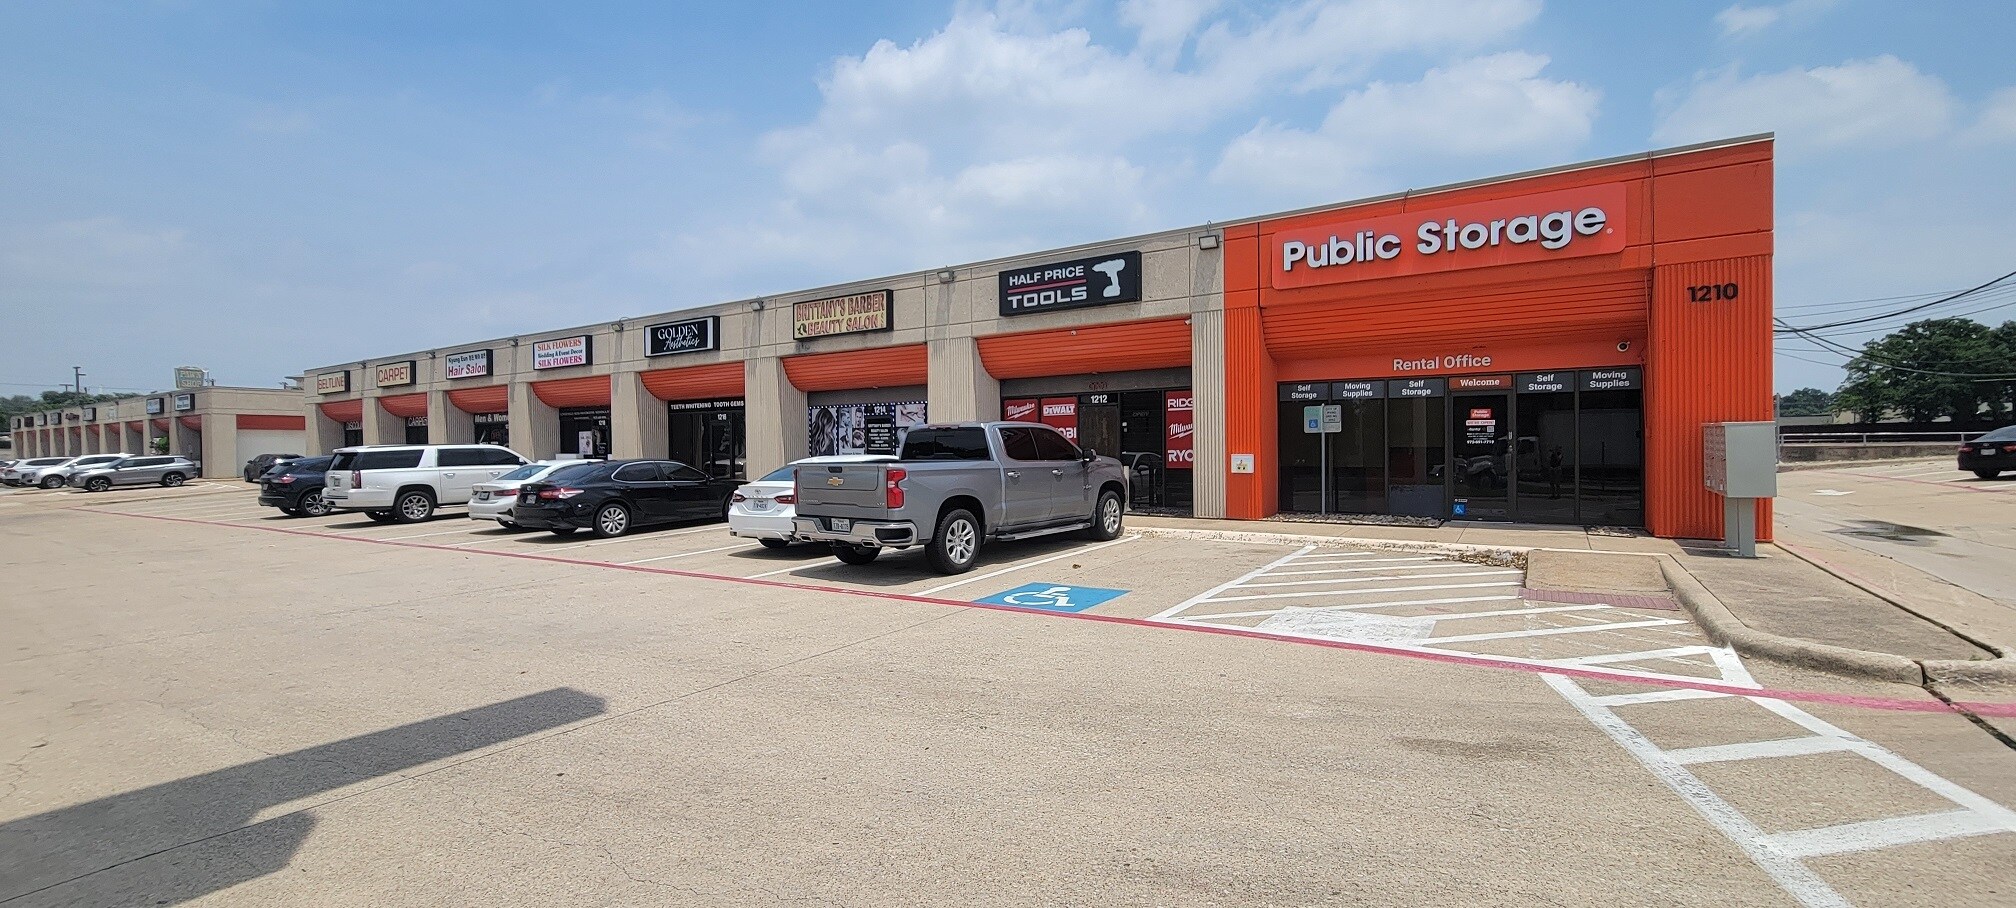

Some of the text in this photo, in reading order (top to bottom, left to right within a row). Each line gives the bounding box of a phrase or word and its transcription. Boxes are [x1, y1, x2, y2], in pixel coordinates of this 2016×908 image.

[1283, 207, 1607, 271] Public Storage
[1009, 265, 1084, 286] HALF PRICE
[1007, 286, 1087, 309] TOOLS
[1687, 283, 1738, 302] 1210
[796, 293, 885, 322] BRITTANY'S BARBER
[808, 318, 845, 335] BEAUTY
[846, 314, 879, 331] SALON
[658, 324, 699, 339] GOLDEN
[537, 338, 582, 351] SILK FLOWERS
[663, 335, 700, 350] Aesthetics
[538, 355, 582, 367] SILK FLOWERS
[1393, 354, 1492, 371] Rental Office
[377, 366, 409, 383] CARPET
[448, 362, 486, 377] Hair Salon
[1459, 377, 1500, 387] Welcome
[1536, 374, 1554, 382] Self
[1592, 371, 1627, 381] Moving
[318, 376, 344, 390] BELTLINE
[1297, 384, 1311, 392] Self
[1344, 382, 1371, 391] Moving
[1408, 380, 1424, 388] Self
[1528, 382, 1563, 392] Storage
[1589, 379, 1630, 389] Supplies
[1291, 391, 1317, 400] Storage
[1342, 390, 1373, 398] Supplies
[1401, 387, 1432, 396] Storage
[1091, 395, 1108, 404] 1212
